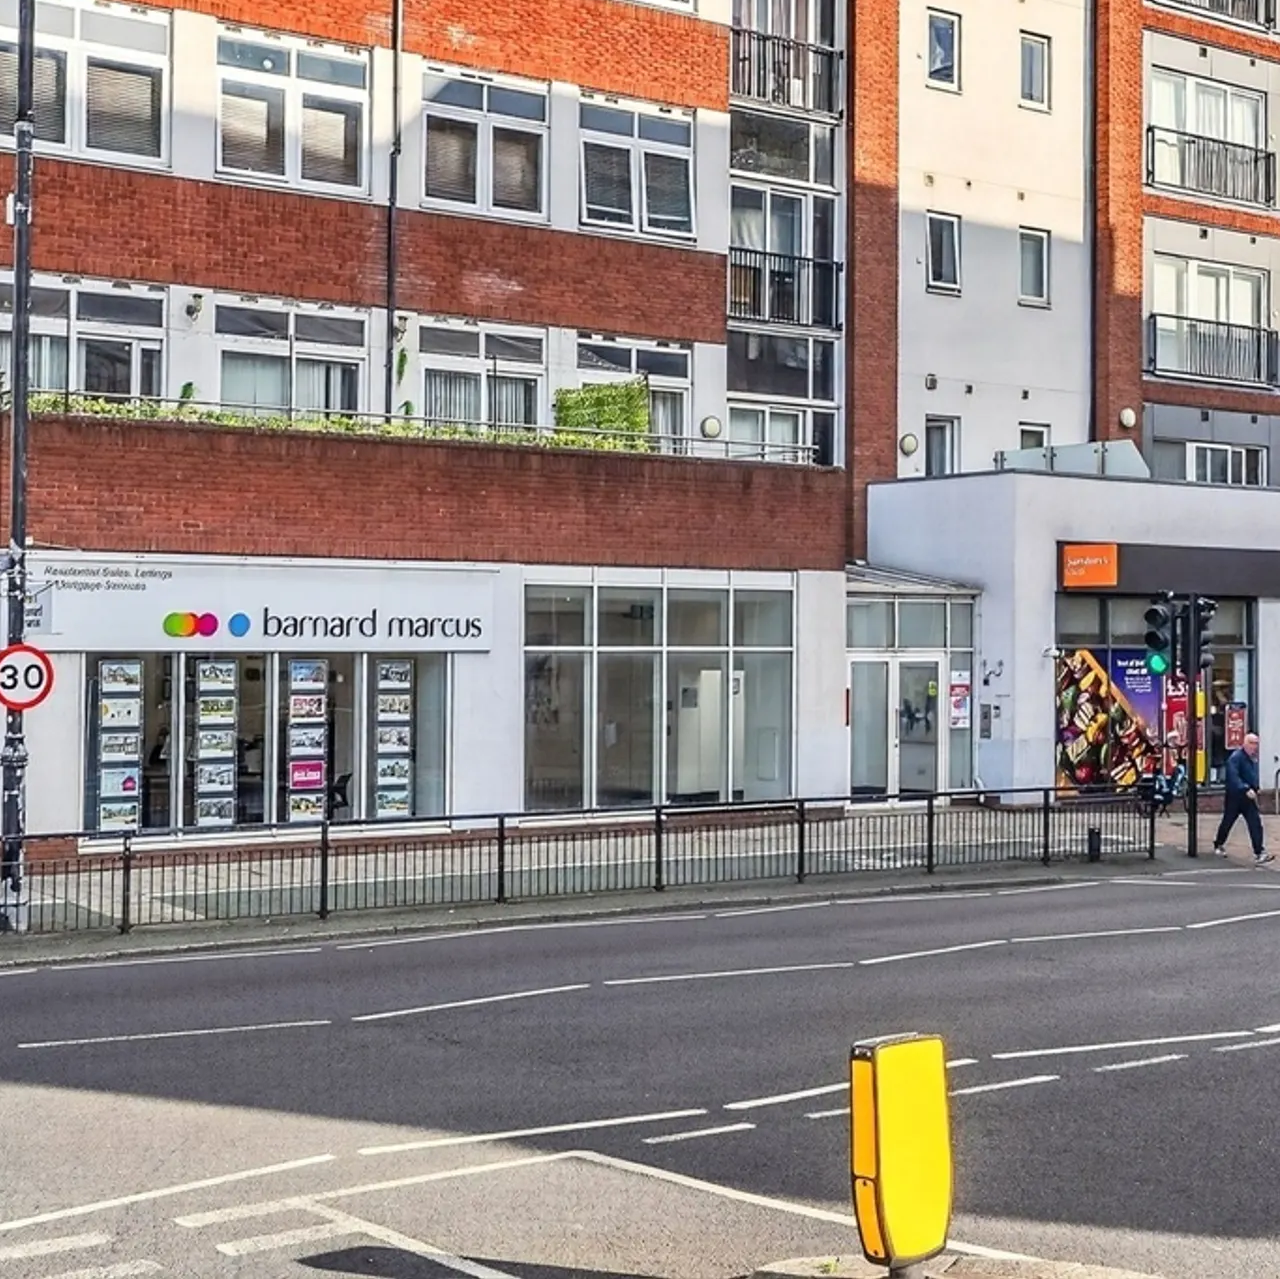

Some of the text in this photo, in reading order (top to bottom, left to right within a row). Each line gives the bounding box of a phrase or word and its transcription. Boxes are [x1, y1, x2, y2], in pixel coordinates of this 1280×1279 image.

[134, 568, 173, 580] Lettings
[263, 607, 483, 638] barnard marcus
[0, 664, 44, 690] 30
